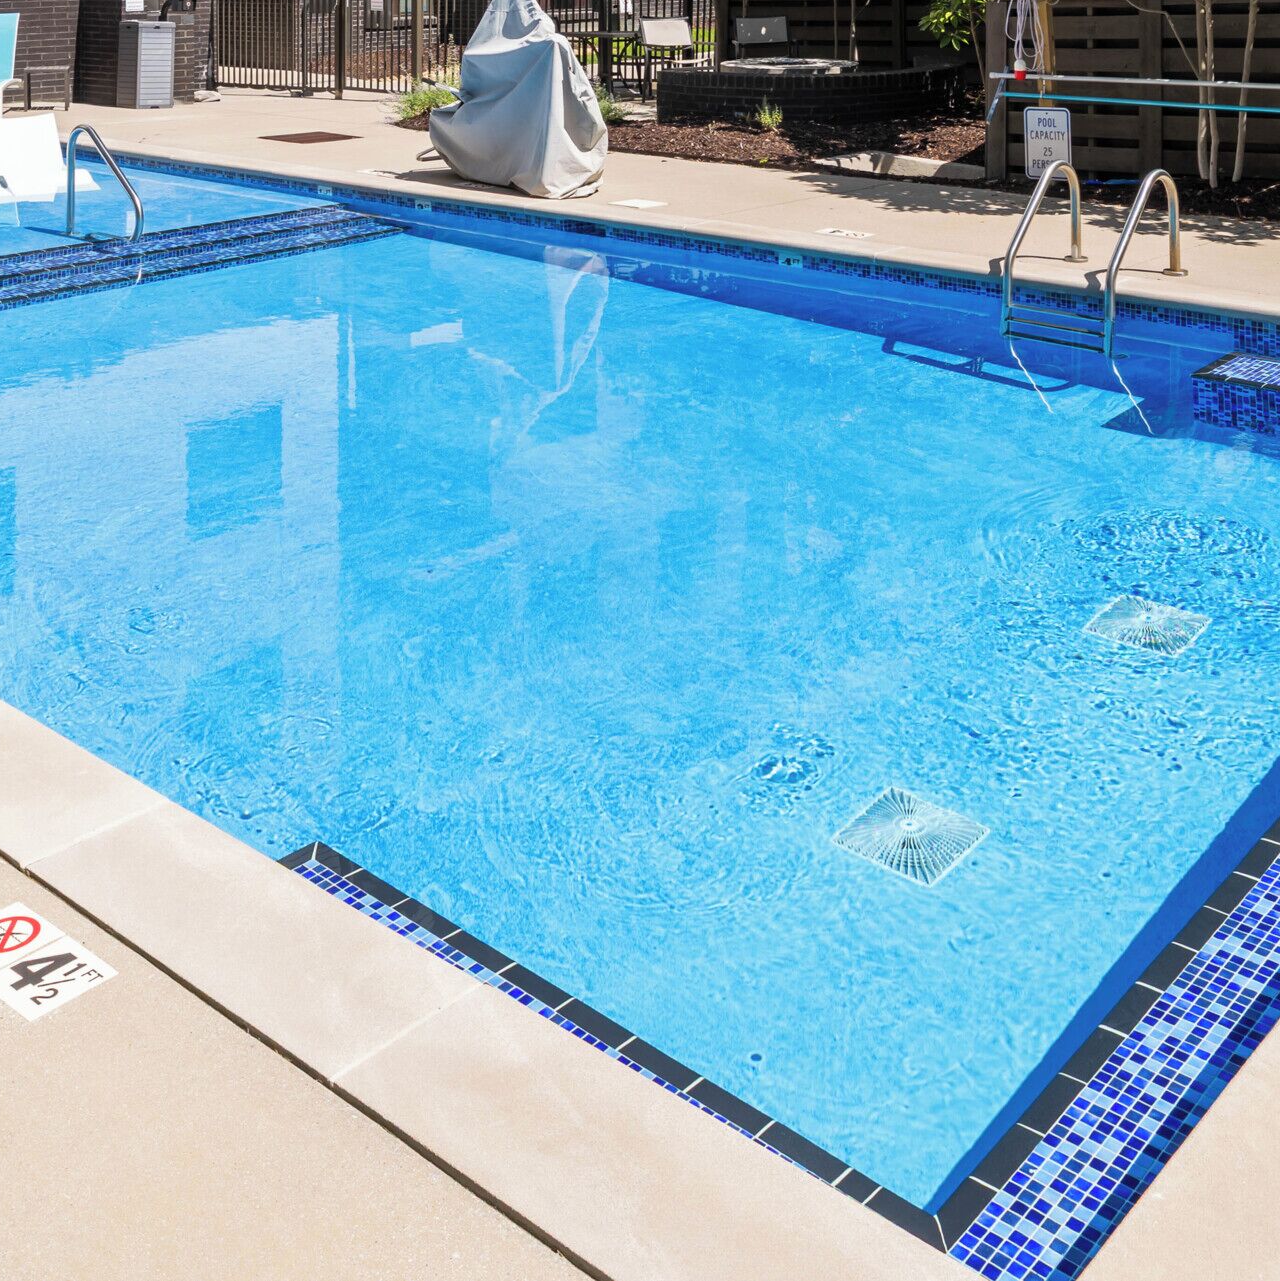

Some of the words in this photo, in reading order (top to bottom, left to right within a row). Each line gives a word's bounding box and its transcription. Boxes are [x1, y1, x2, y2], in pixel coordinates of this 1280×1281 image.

[1037, 117, 1057, 128] POOL
[1029, 130, 1066, 141] CAPACITY
[1043, 146, 1053, 157] 25
[1032, 159, 1054, 169] PERS
[9, 952, 78, 991] 4
[80, 968, 104, 983] FT
